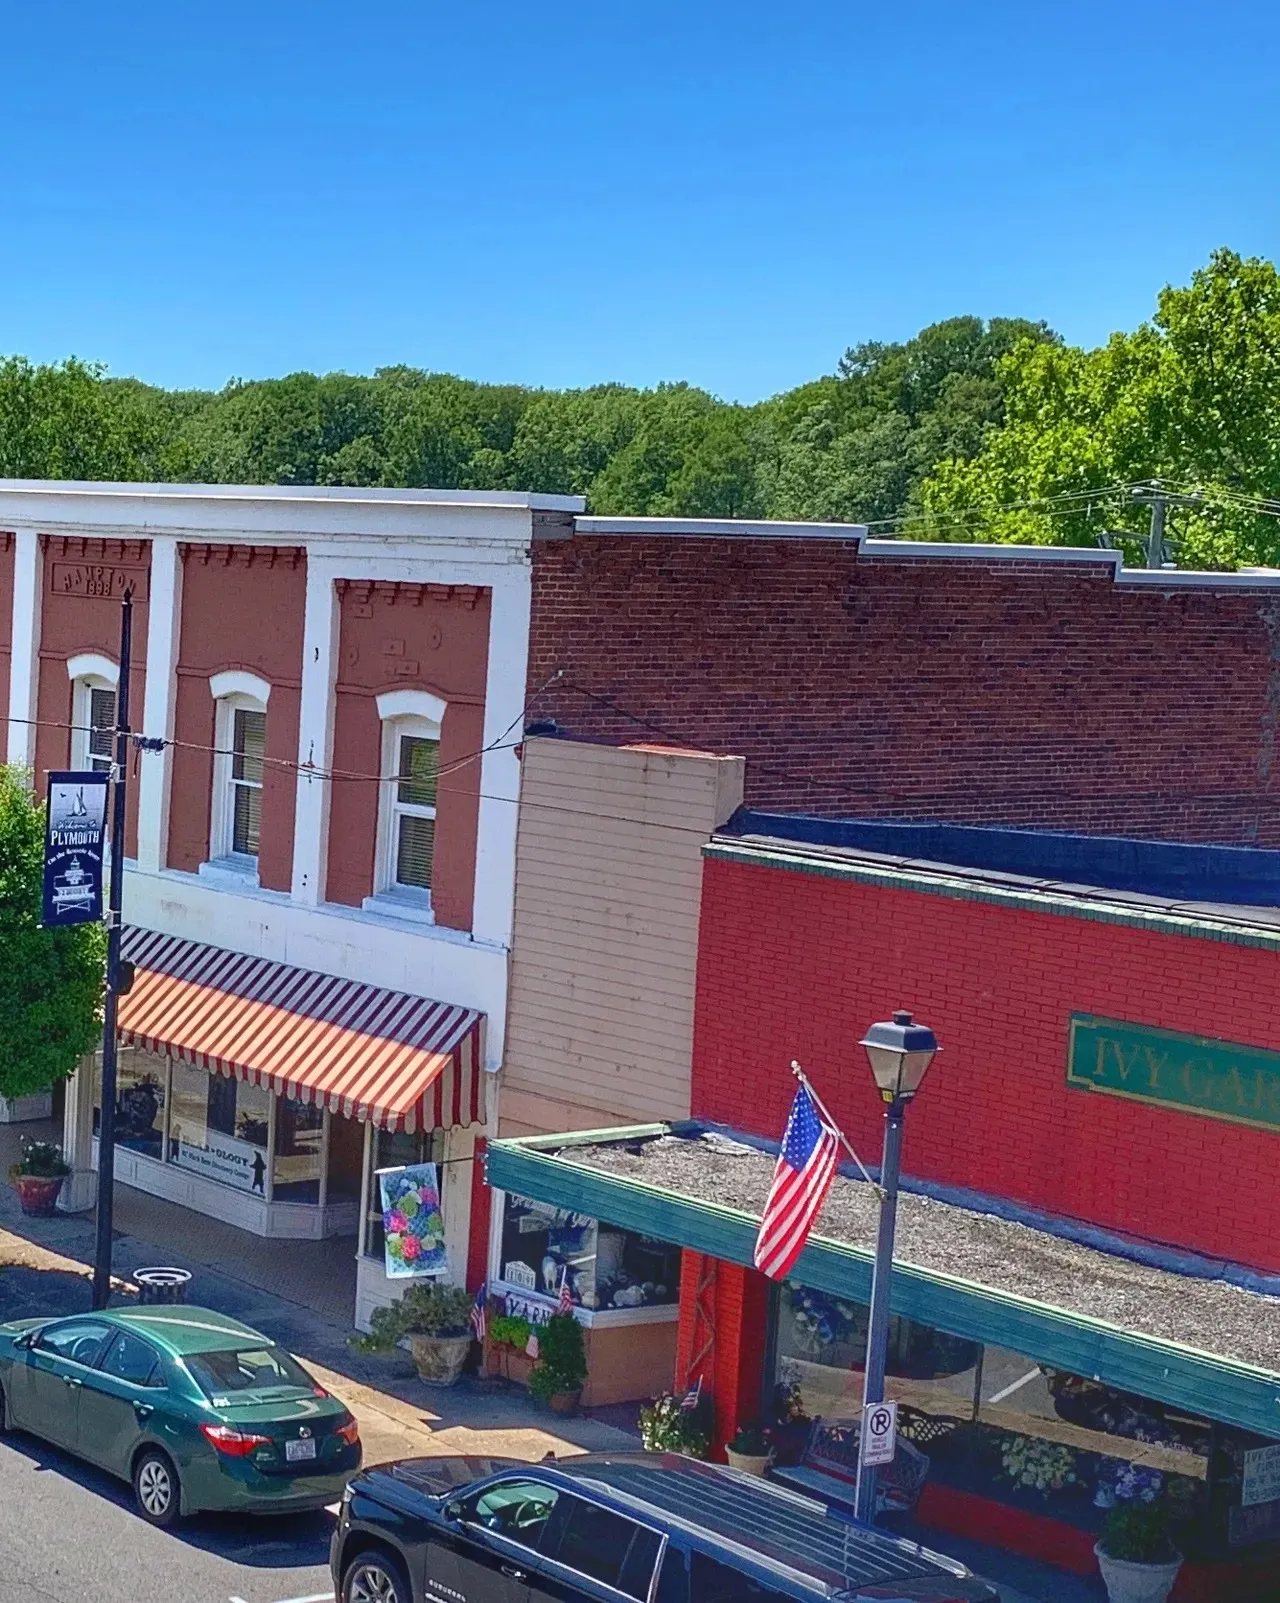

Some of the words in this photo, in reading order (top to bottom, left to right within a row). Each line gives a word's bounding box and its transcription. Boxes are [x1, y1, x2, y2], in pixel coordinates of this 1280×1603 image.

[86, 580, 111, 597] 1898
[50, 830, 100, 846] PLYMOUTH
[1092, 1036, 1170, 1088] IVY
[510, 1297, 551, 1327] YARN
